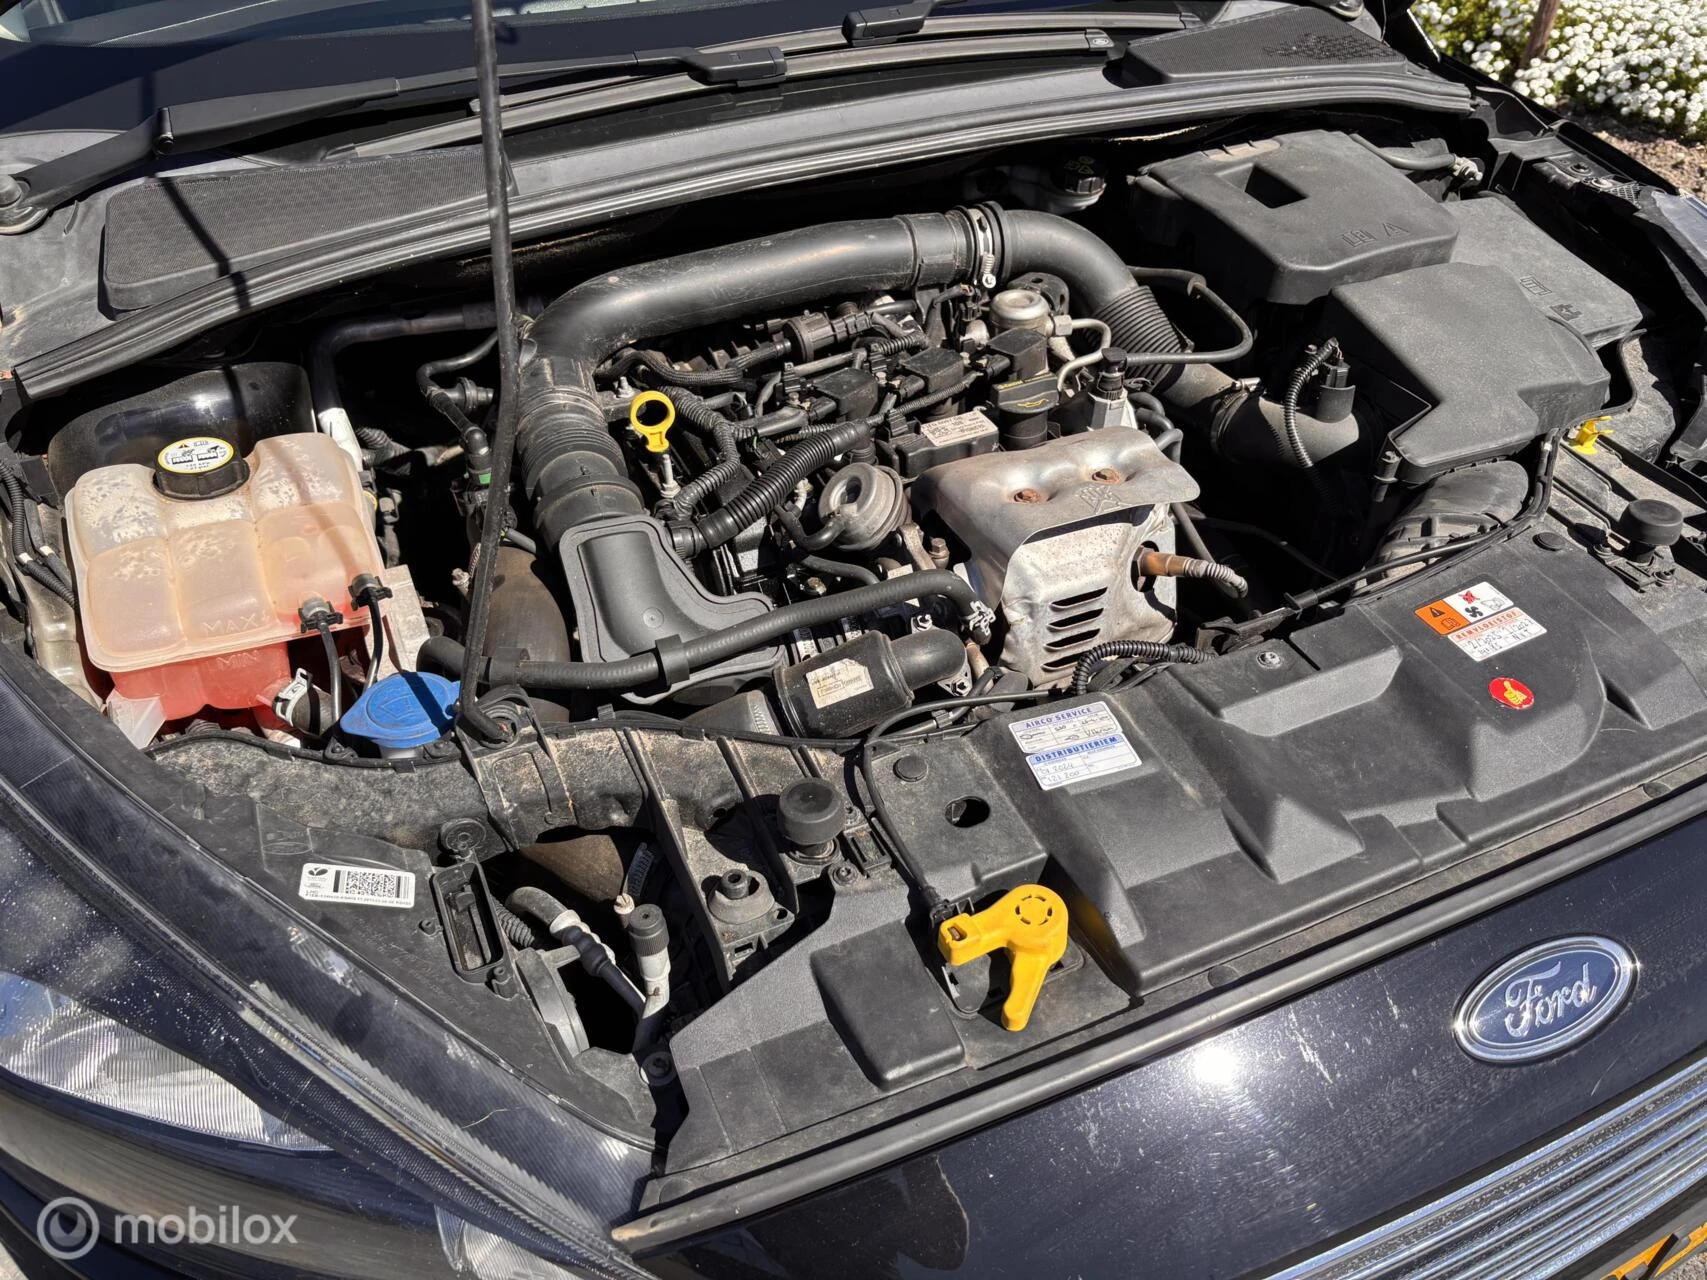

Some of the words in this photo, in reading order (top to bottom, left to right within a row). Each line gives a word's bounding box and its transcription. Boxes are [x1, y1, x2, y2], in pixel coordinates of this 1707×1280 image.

[202, 612, 259, 635] MAX
[1025, 716, 1053, 729] AIRCO
[1054, 707, 1092, 721] SERVICE
[1035, 736, 1118, 762] DISTRIBUTIERIEM
[1503, 960, 1598, 1038] Ford
